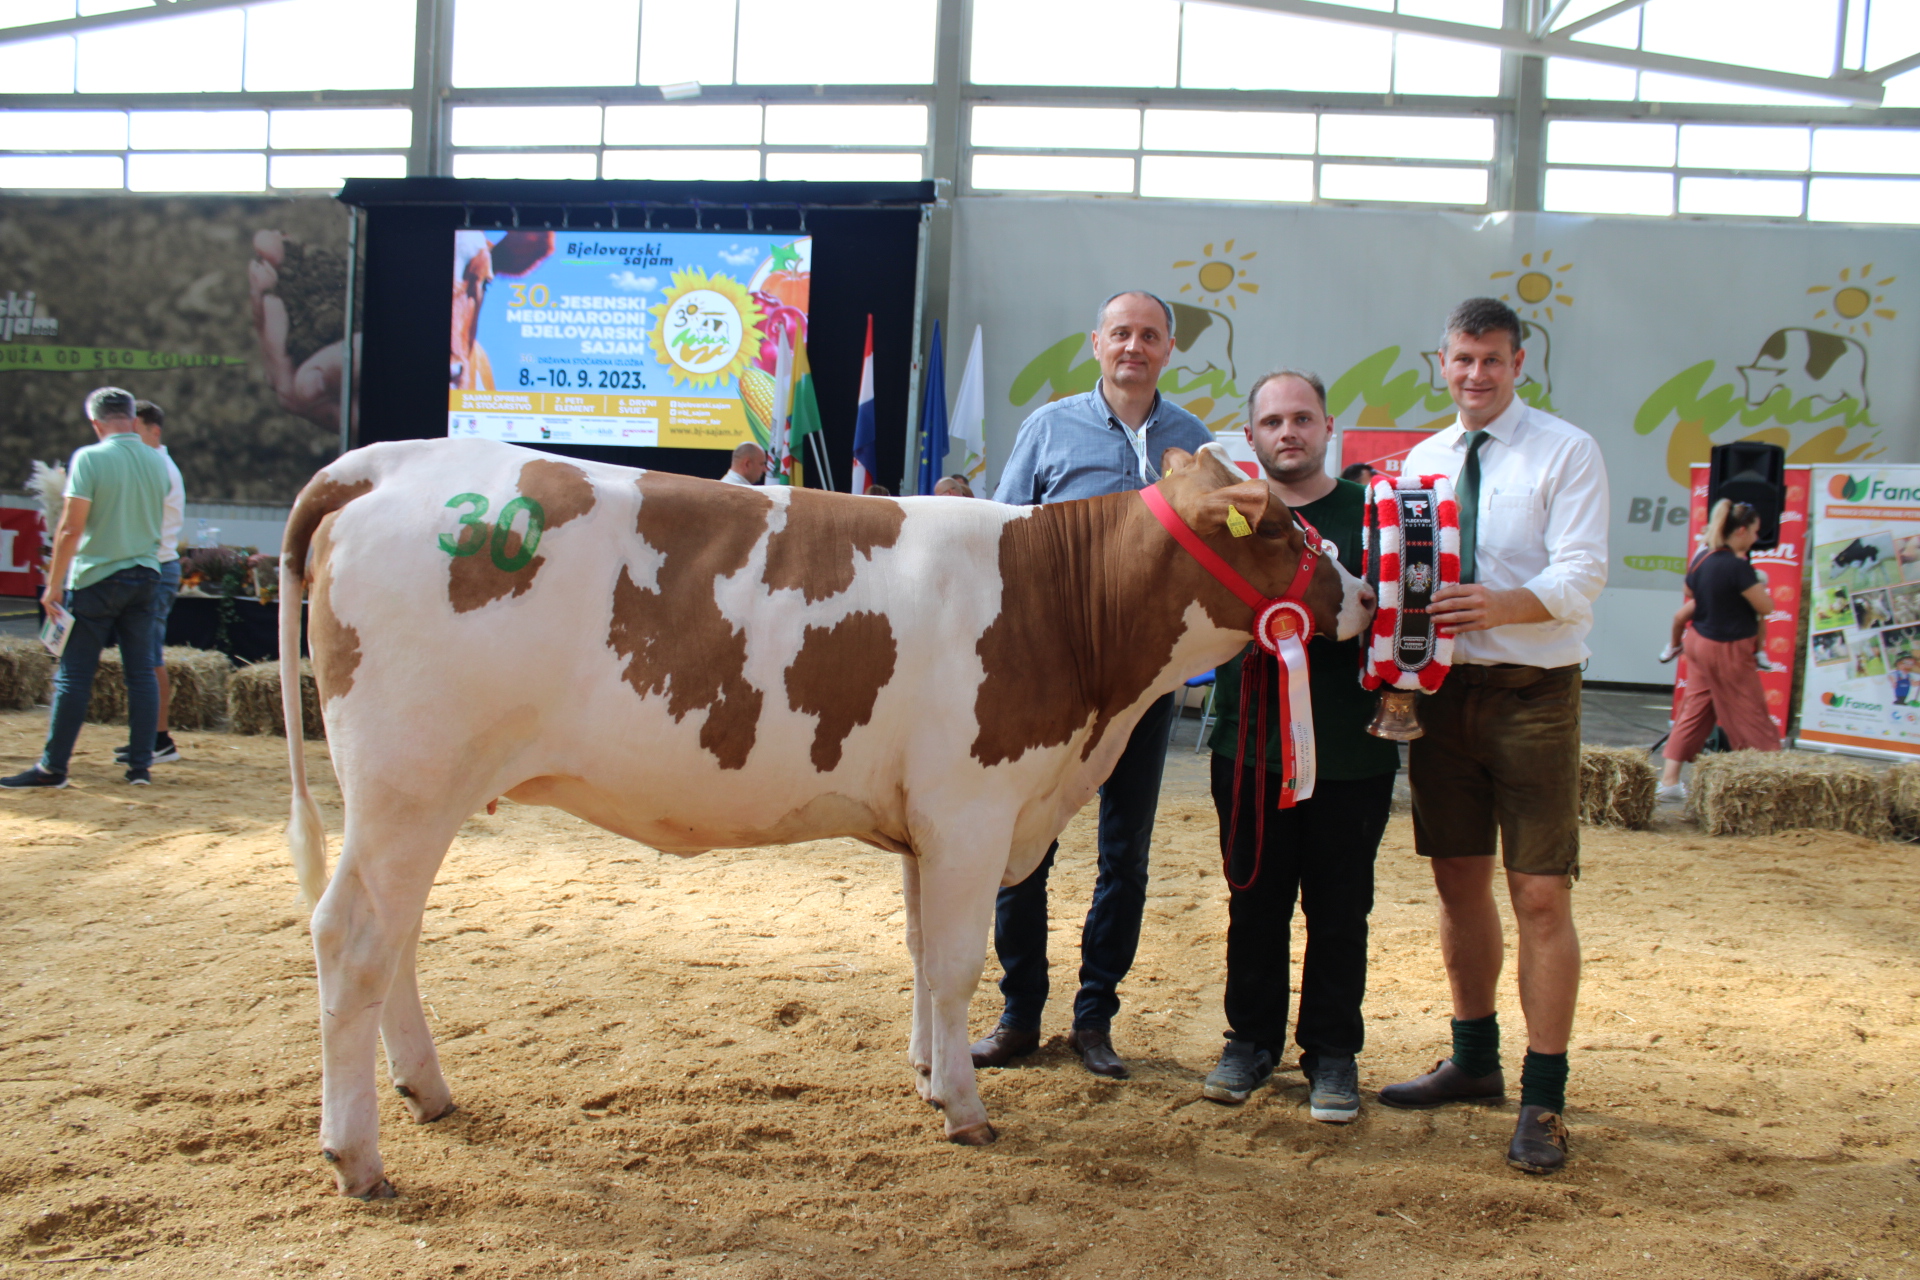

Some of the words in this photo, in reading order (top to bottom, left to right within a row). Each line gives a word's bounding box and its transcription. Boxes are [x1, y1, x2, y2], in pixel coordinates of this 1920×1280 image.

[567, 242, 662, 258] Bjelovarski
[624, 256, 673, 268] sajam
[508, 283, 558, 308] 30.
[560, 295, 647, 310] JESENSKI
[506, 309, 646, 325] MEĐUNARODNI
[520, 324, 645, 341] BJELOVARSKI
[581, 340, 645, 355] SAJAM
[56, 350, 81, 364] OD
[578, 369, 593, 388] 9.
[598, 370, 647, 389] 2023.
[462, 394, 492, 402] SAJAM
[493, 394, 529, 403] OPREME
[564, 397, 584, 405] PETI
[628, 399, 657, 407] DRVNI
[461, 401, 475, 409] ZA
[475, 401, 532, 411] STOČARSTVO
[554, 404, 595, 412] ELEMENT
[670, 427, 743, 437] www.bj-sajam.hr
[437, 492, 545, 573] 30
[1845, 697, 1882, 711] Fanon
